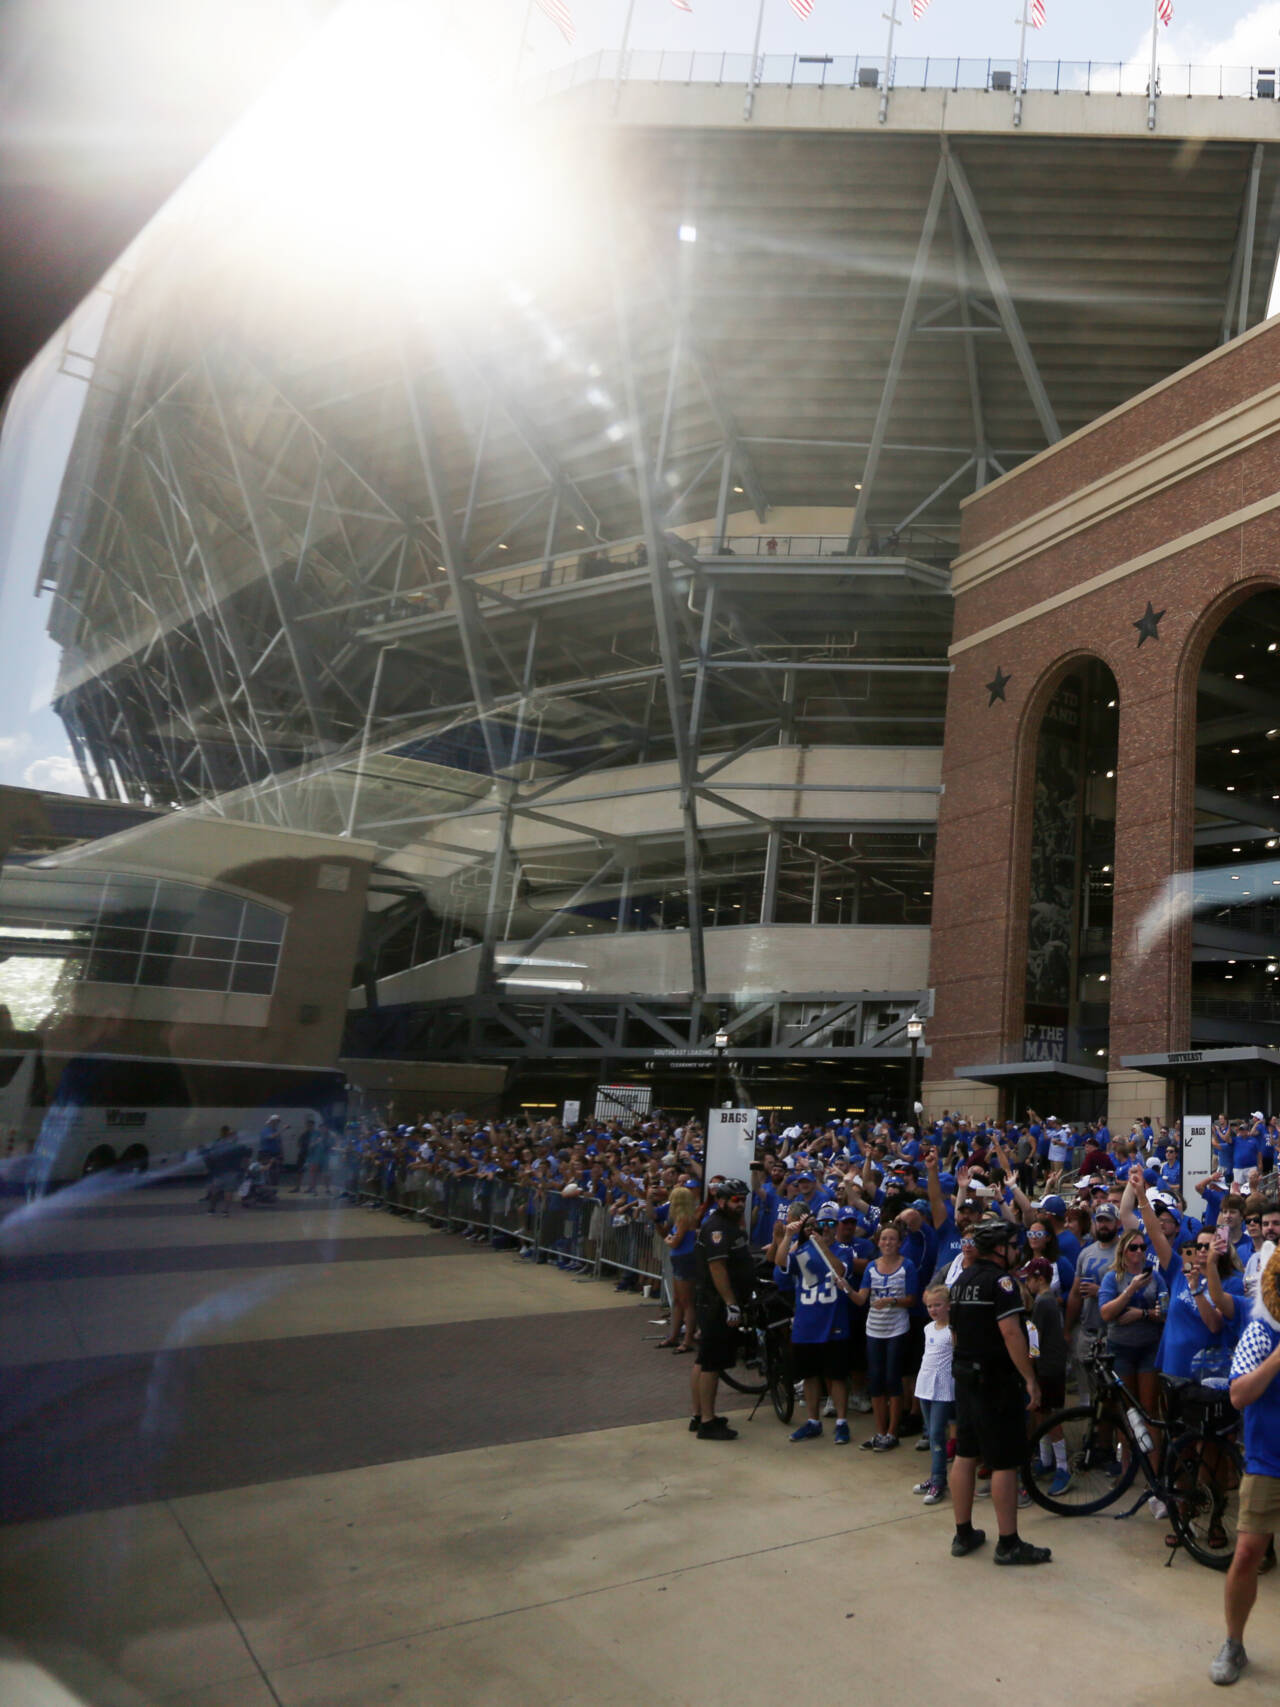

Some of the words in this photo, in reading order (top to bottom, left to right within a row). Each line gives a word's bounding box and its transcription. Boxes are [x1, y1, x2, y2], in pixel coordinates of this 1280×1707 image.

[1039, 1025, 1065, 1041] THE
[1024, 1041, 1065, 1062] MAN
[1168, 1052, 1203, 1063] SOUTHEAST
[720, 1112, 748, 1123] BAGS
[1191, 1127, 1206, 1136] BAGS
[950, 1284, 980, 1301] OLICE
